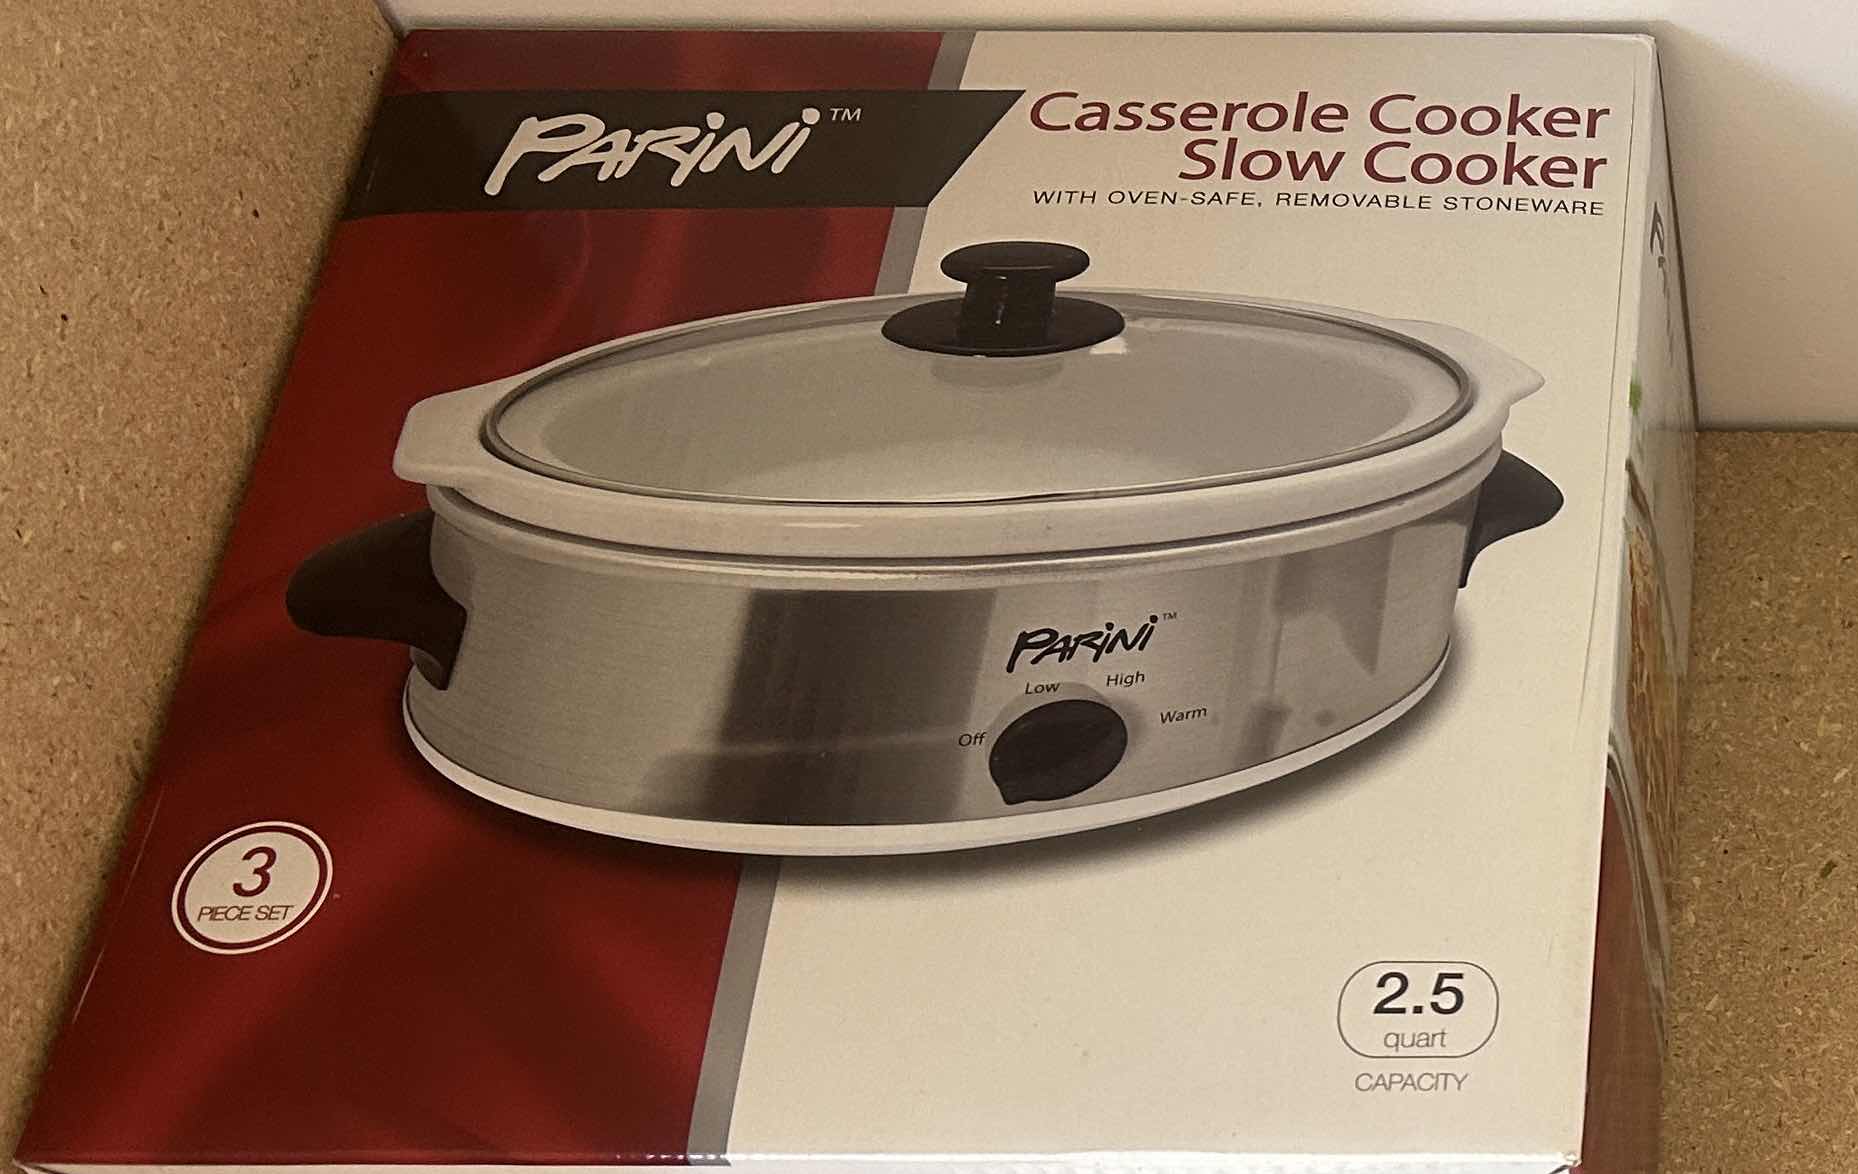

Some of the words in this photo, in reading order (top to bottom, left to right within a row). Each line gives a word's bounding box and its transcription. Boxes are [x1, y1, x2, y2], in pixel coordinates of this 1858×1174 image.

[1029, 90, 1350, 134] Casserole
[1369, 93, 1611, 139] Cooker
[1178, 137, 1346, 183] Slow
[1364, 140, 1608, 190] Cooker
[1033, 189, 1097, 206] WITH
[1106, 190, 1264, 208] OVEN-SAFE,
[1275, 193, 1433, 211] REMOVABLE
[1442, 195, 1605, 216] STONEWARE
[1024, 681, 1061, 695] Low
[1105, 670, 1146, 688] High
[1159, 705, 1208, 725] Warm
[957, 731, 987, 748] Off
[231, 846, 278, 898] 3
[197, 905, 253, 922] PIECE
[254, 904, 294, 921] SET
[1372, 971, 1465, 1016] 2.5
[1382, 1028, 1448, 1052] quart
[1354, 1071, 1469, 1092] CAPACITY
